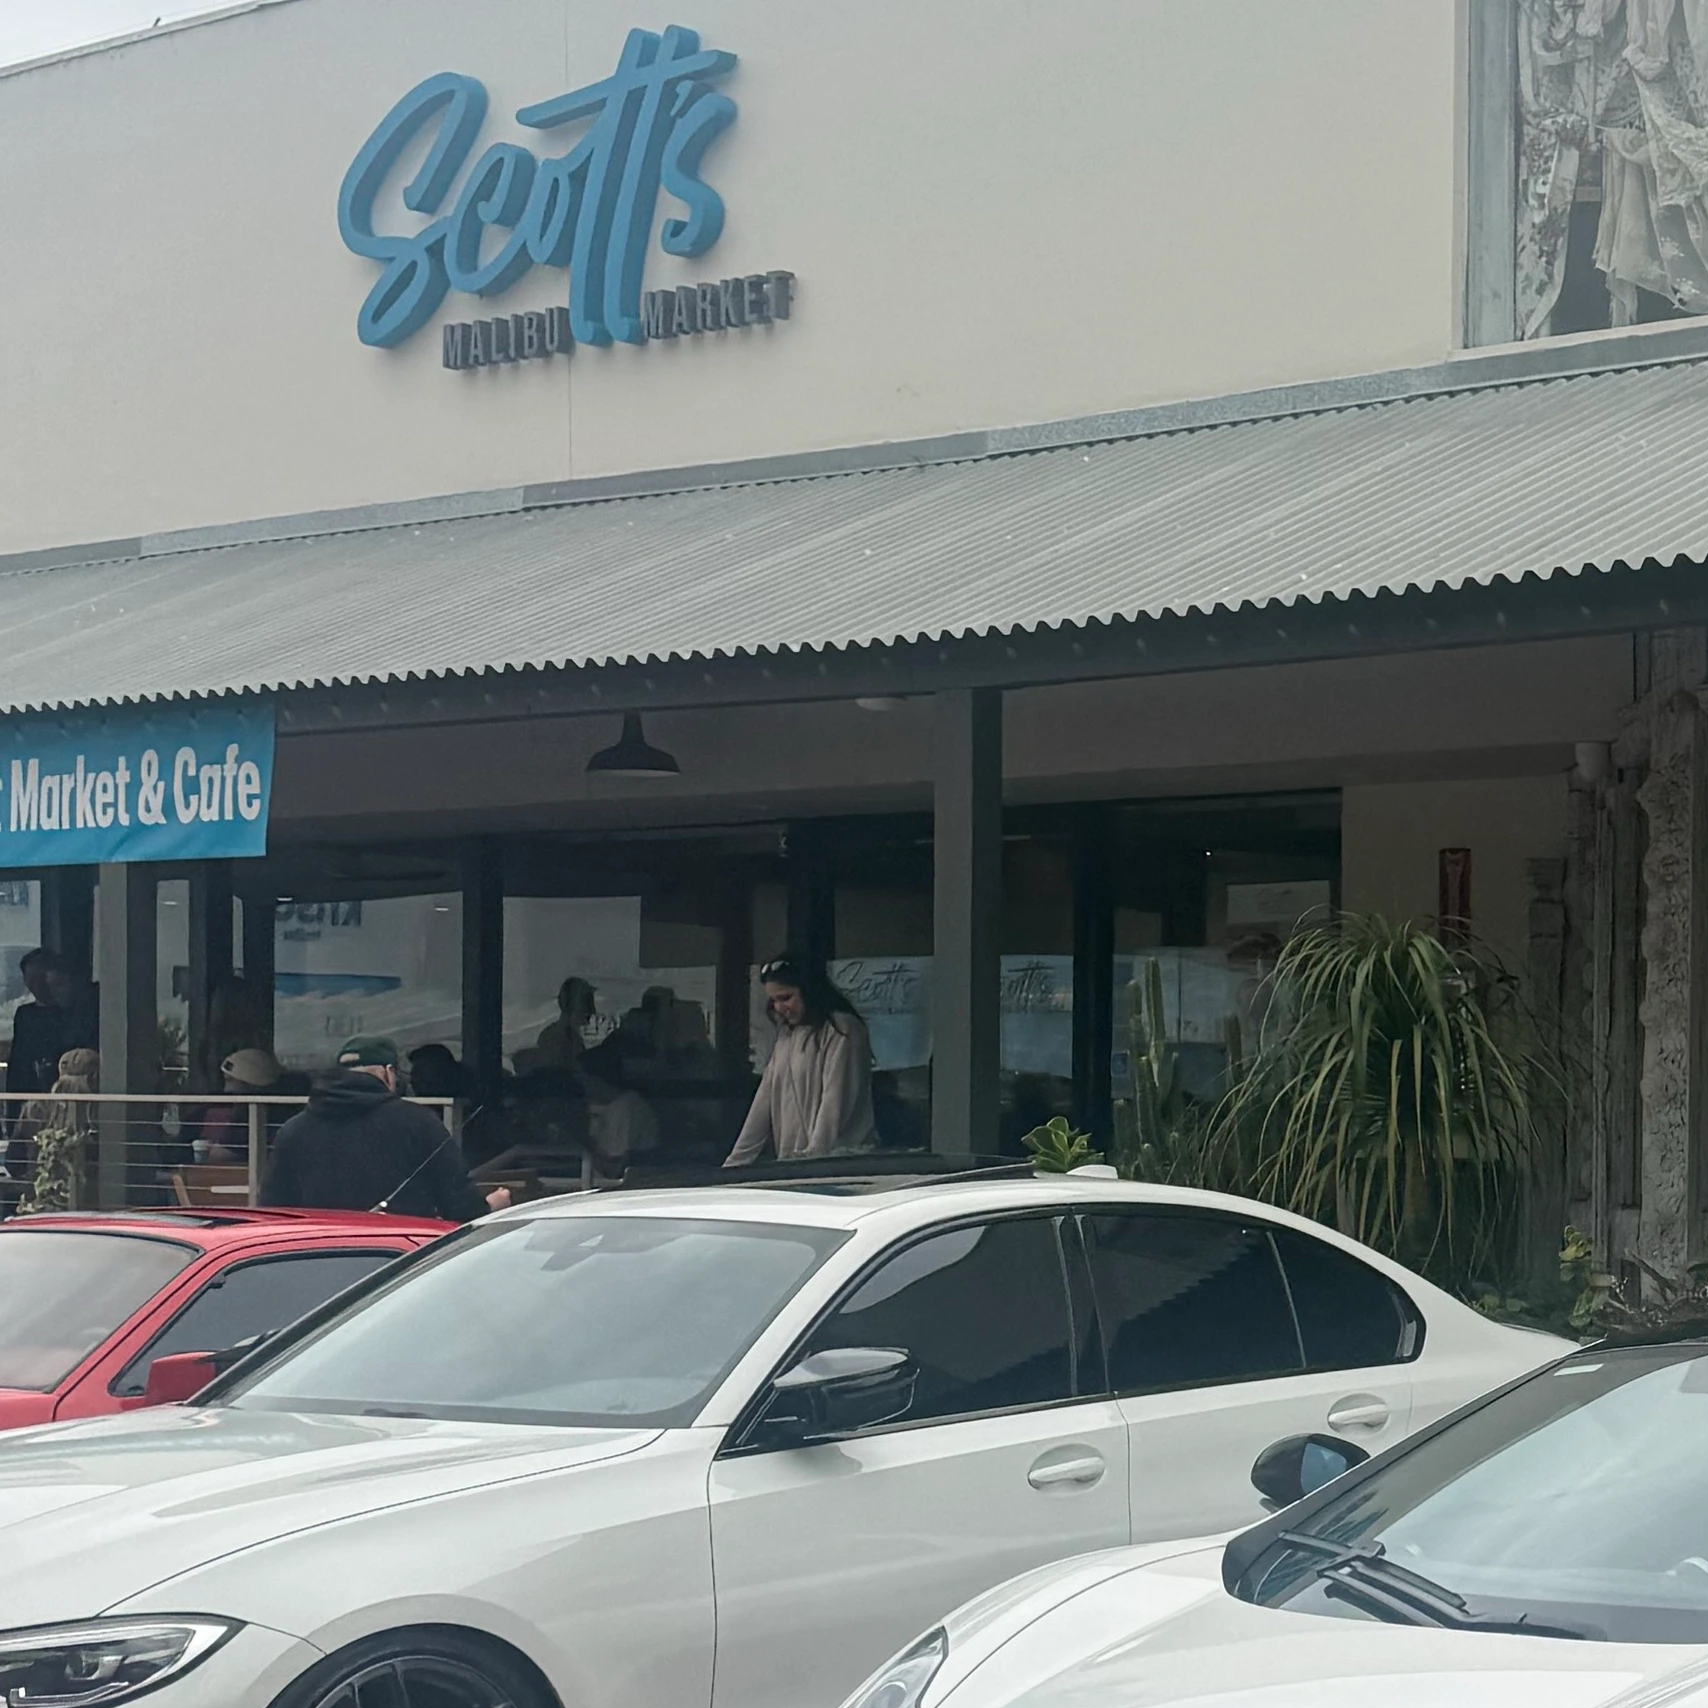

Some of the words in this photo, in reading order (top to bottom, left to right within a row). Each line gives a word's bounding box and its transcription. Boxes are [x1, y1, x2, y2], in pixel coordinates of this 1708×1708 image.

[337, 24, 738, 348] Scott's
[443, 306, 575, 370] MALIBU
[642, 270, 796, 340] MARKET
[9, 755, 130, 832] Market
[138, 748, 167, 826] &
[172, 743, 262, 824] Cafe
